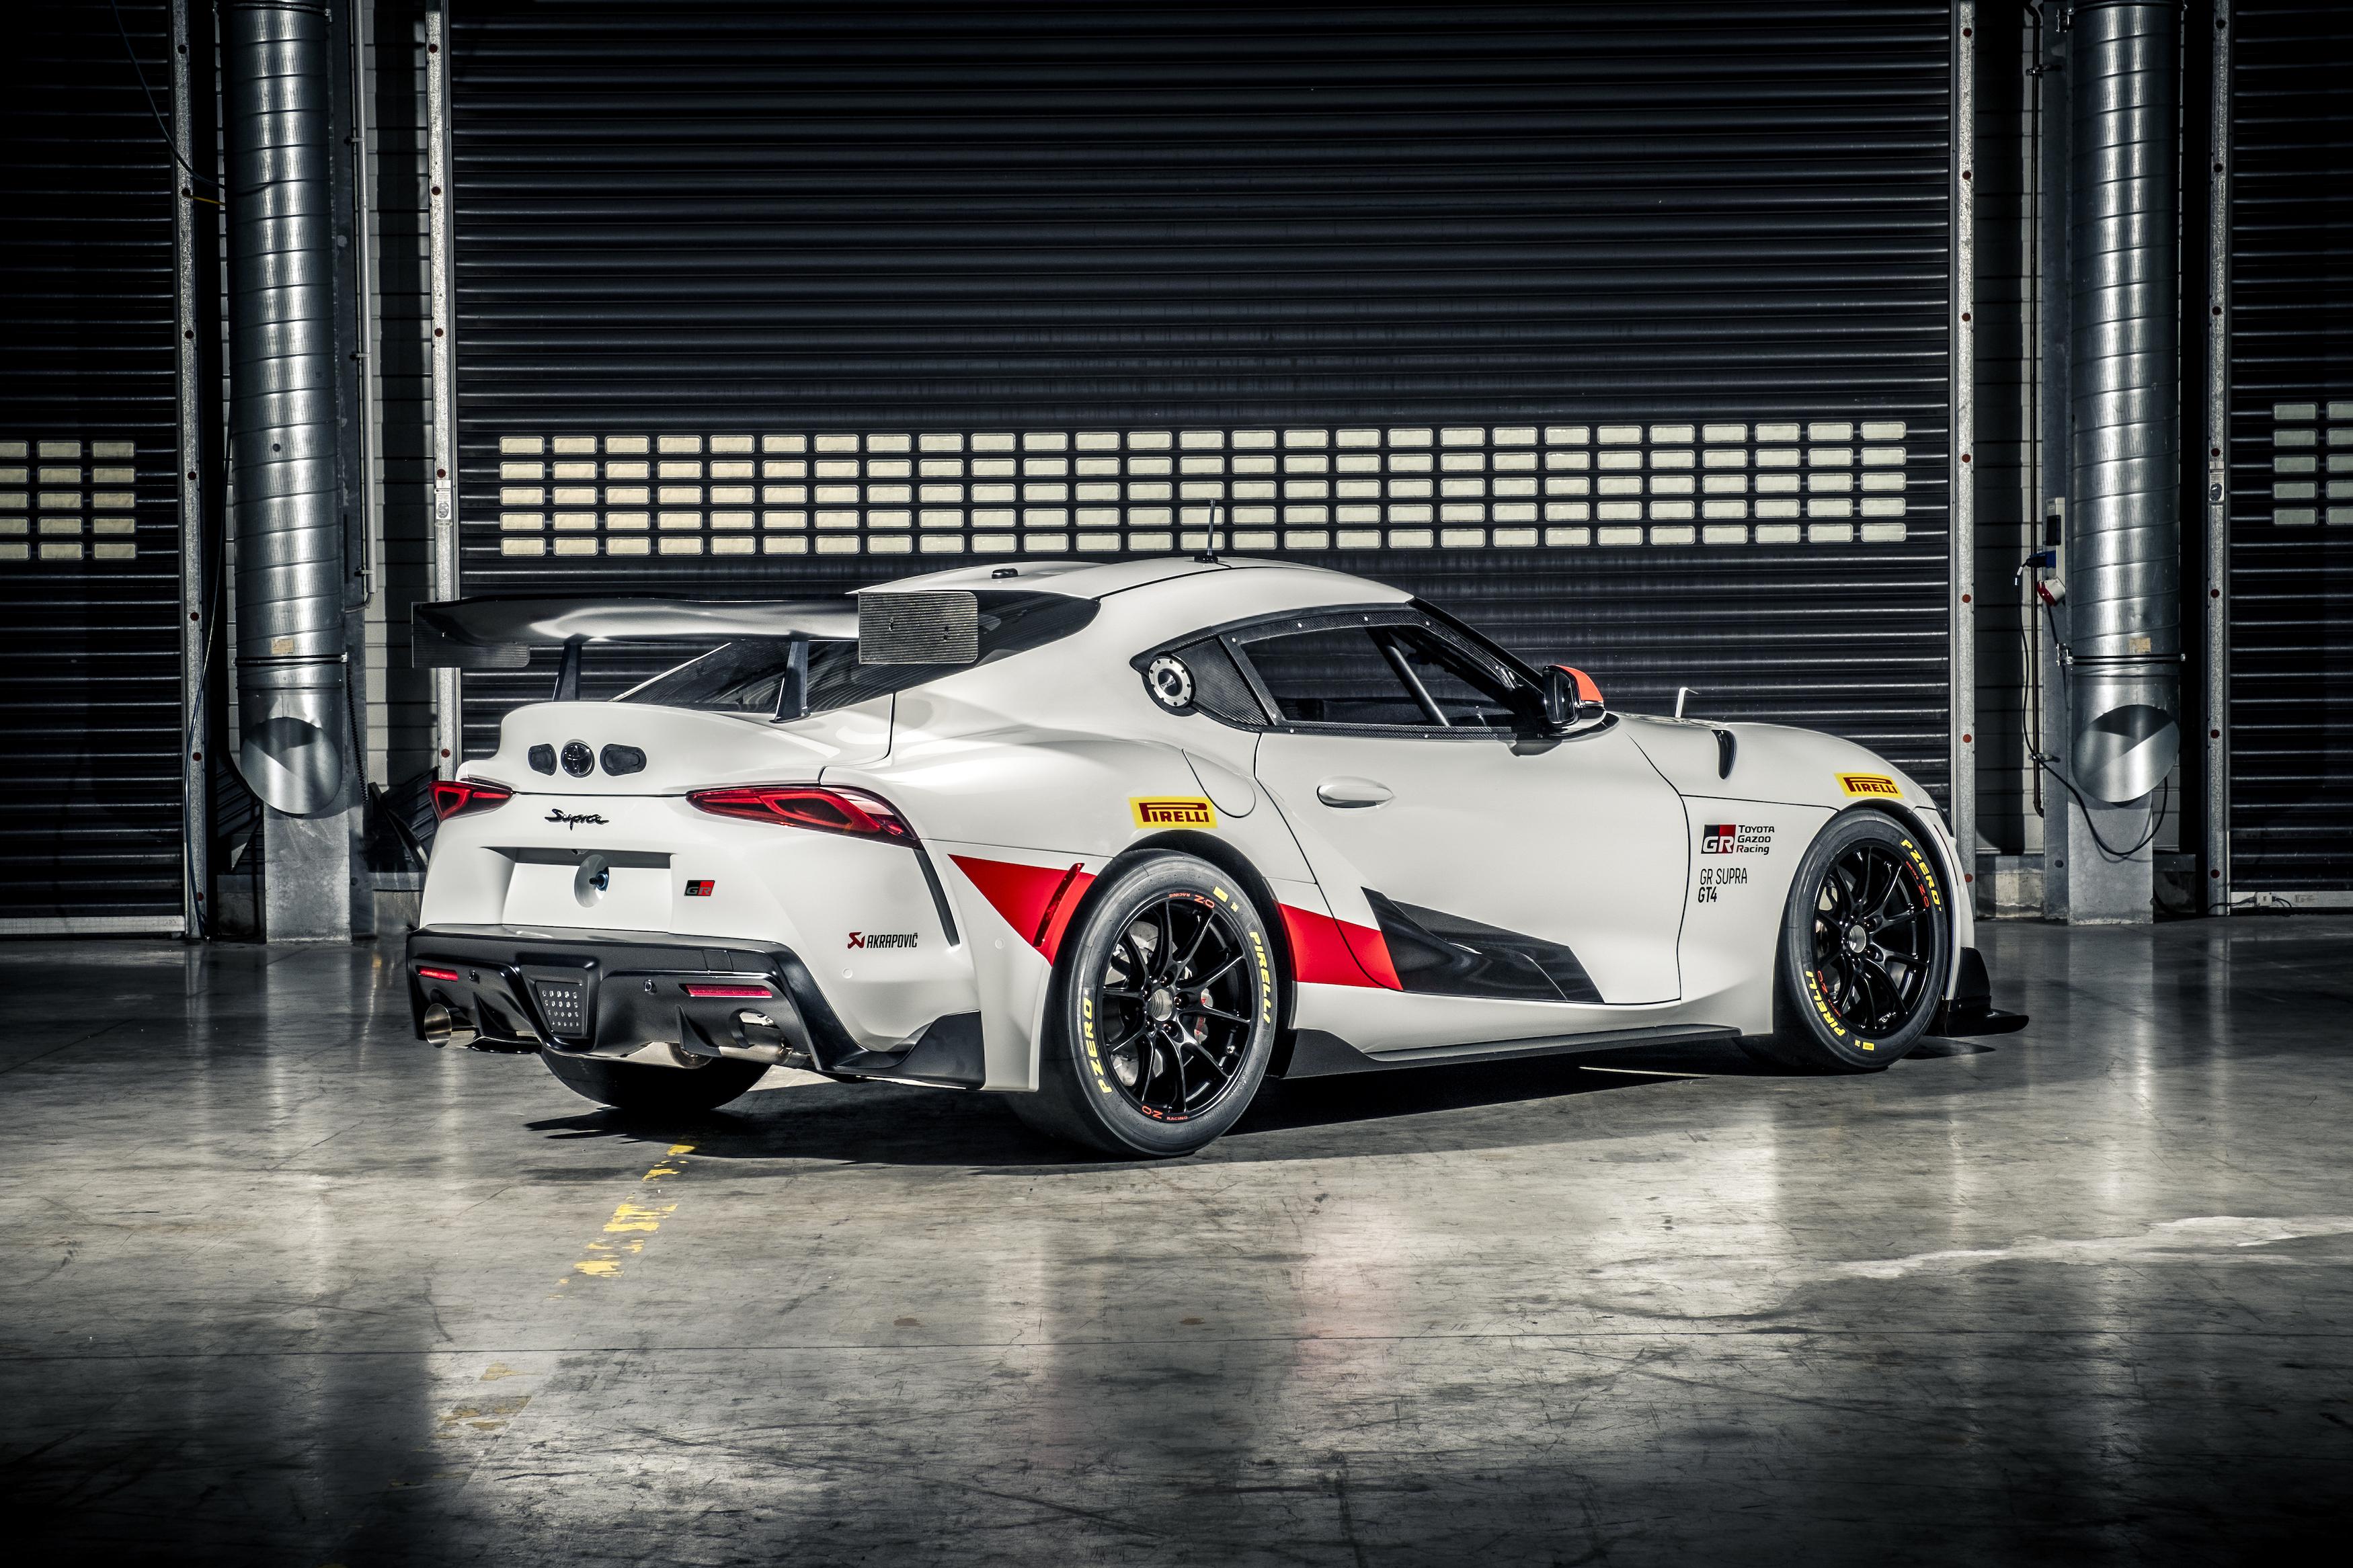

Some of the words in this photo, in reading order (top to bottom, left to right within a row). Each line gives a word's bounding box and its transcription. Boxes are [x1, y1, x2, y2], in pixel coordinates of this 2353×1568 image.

[1843, 777, 1899, 794] PIRELLI
[544, 808, 610, 831] Supra
[1138, 802, 1210, 823] PIRELLI
[1738, 825, 1775, 833] TOYOTA
[1702, 835, 1734, 853] GR
[1737, 835, 1771, 843] GAZOO
[1736, 844, 1769, 856] Racing
[1700, 868, 1714, 885] GR
[1715, 867, 1748, 885] SUPRA
[1698, 886, 1718, 903] GT4
[1248, 932, 1272, 1024] PIRELLI
[1805, 971, 1846, 1036] PIRELLI
